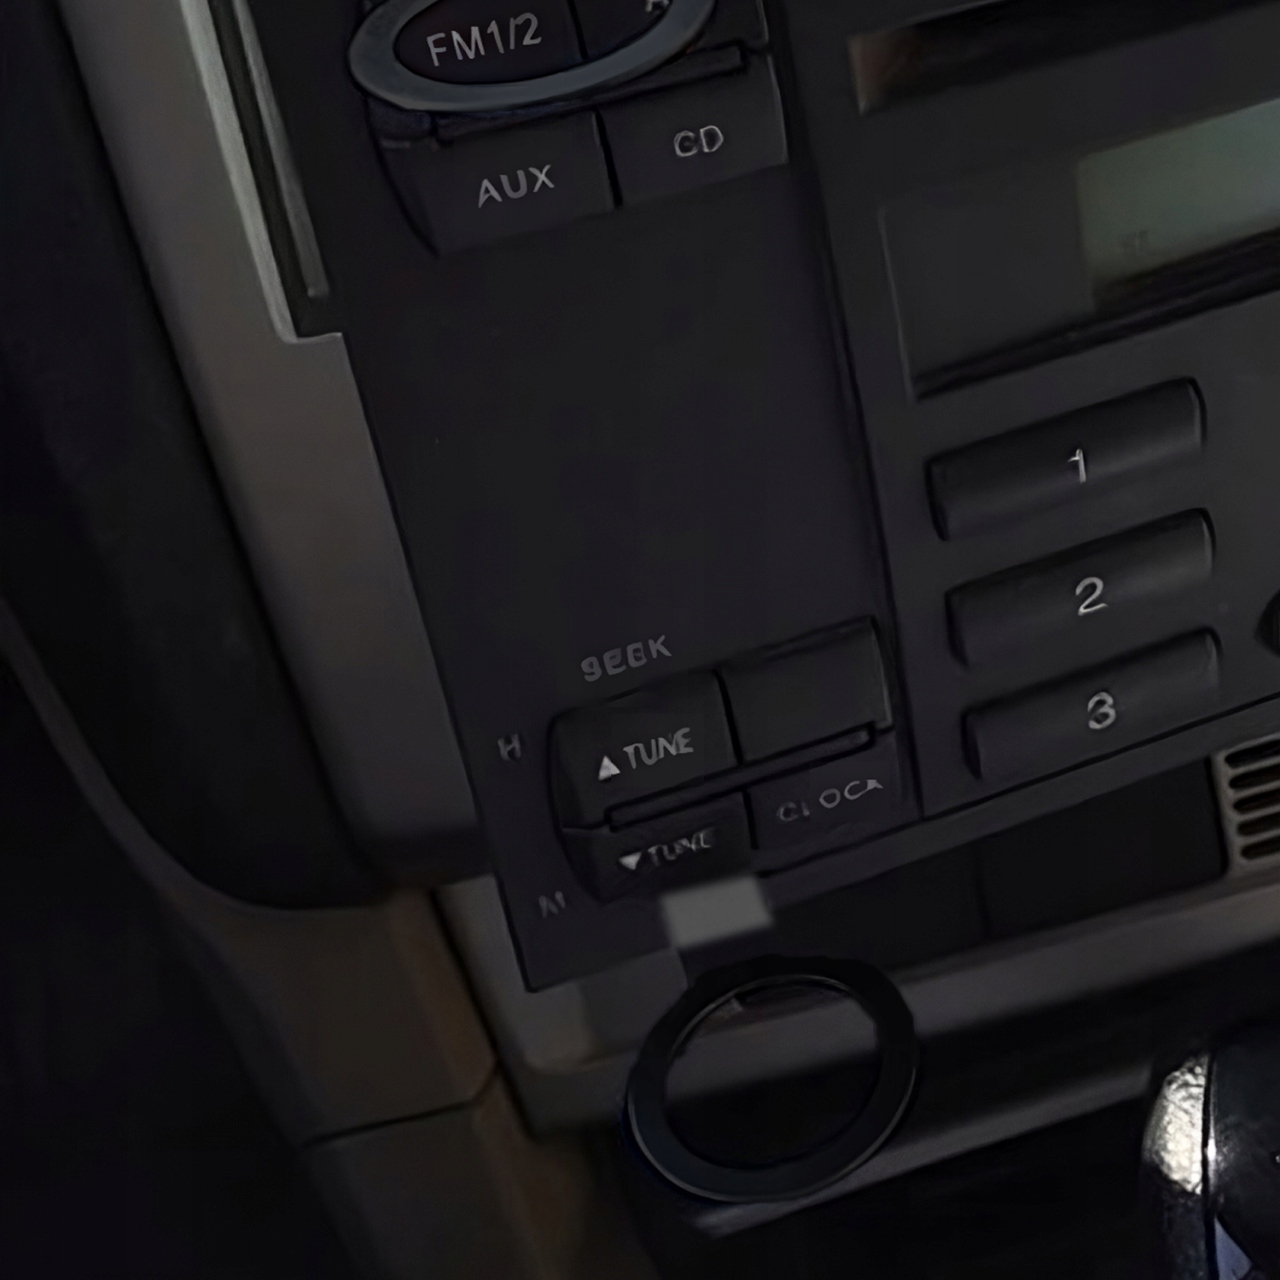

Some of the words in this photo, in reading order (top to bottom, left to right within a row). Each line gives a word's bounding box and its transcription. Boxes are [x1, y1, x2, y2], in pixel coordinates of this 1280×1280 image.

[426, 12, 543, 67] FM1/2
[673, 124, 725, 157] CD
[477, 164, 556, 208] AUX
[1067, 448, 1087, 483] 1
[1075, 576, 1108, 616] 2
[580, 634, 672, 682] SEEK
[1087, 691, 1117, 730] 3
[623, 727, 694, 770] TUNE
